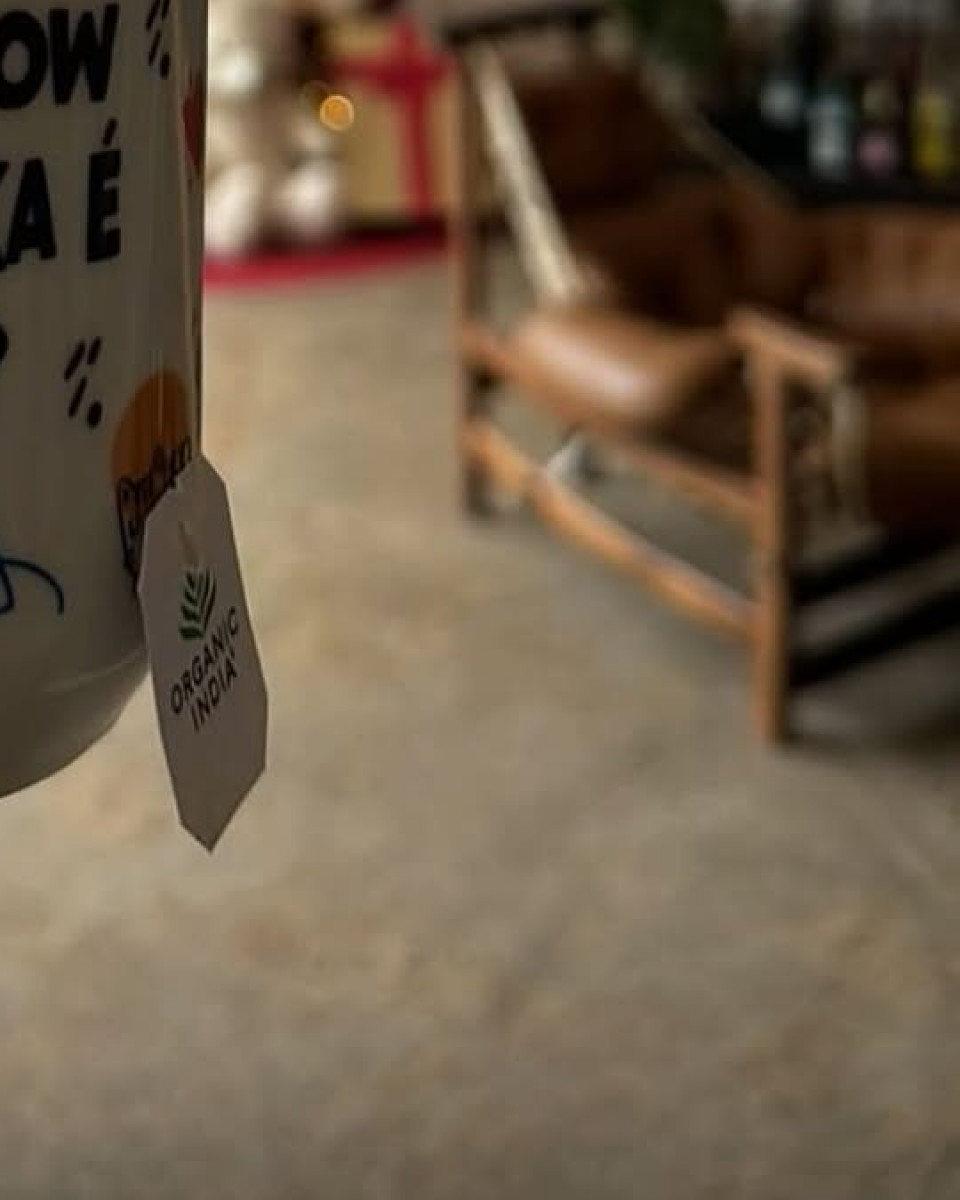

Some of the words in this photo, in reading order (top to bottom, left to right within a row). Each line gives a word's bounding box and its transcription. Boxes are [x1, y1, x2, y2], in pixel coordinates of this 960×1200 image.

[86, 118, 122, 263] É
[170, 606, 239, 715] ORGANIC
[189, 655, 238, 732] INDIA
